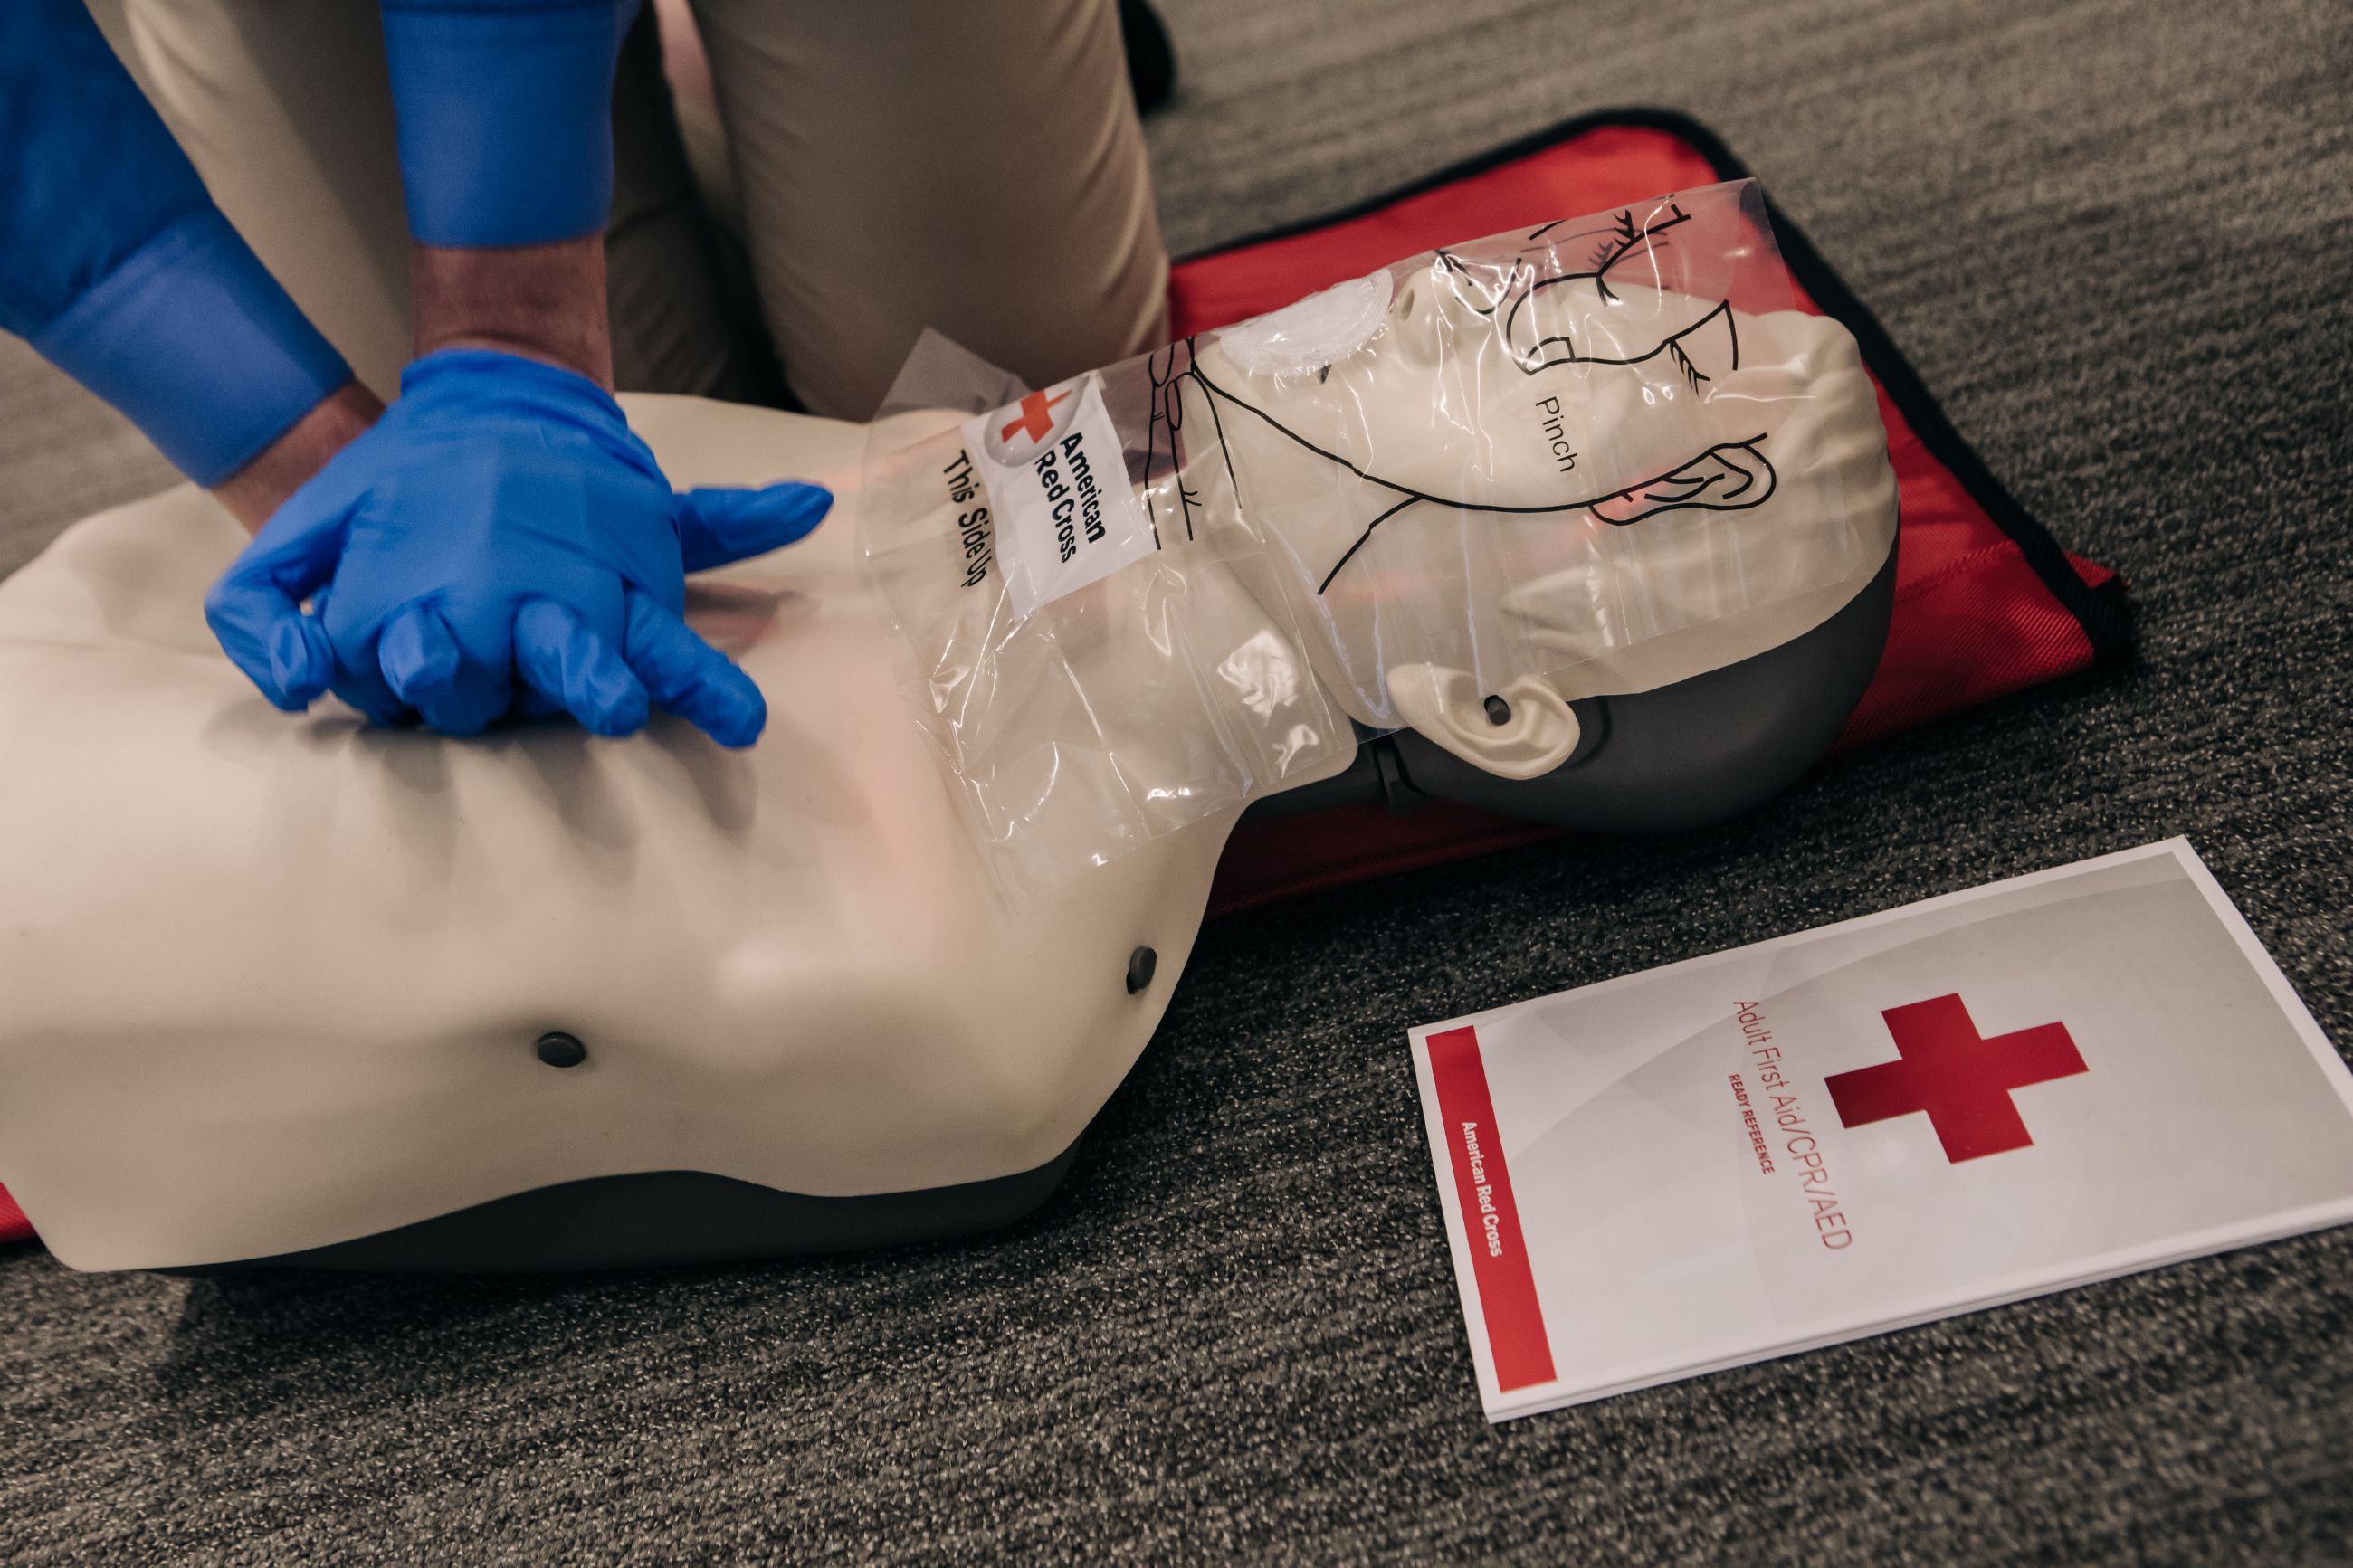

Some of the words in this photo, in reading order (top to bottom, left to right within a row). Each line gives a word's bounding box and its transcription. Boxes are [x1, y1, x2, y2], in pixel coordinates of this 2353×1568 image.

[1535, 396, 1578, 472] Pinch
[943, 449, 980, 504] This
[1060, 432, 1106, 544] American
[957, 507, 992, 558] Side
[1034, 449, 1070, 502] Red
[1052, 499, 1077, 564] Cross
[960, 552, 992, 588] Up
[1733, 1001, 1772, 1046] Adult
[1752, 1047, 1790, 1091] First
[1729, 1074, 1751, 1107] READY
[1741, 1110, 1776, 1175] REFERENCE
[1462, 1122, 1487, 1184] American
[1769, 1095, 1853, 1250] Aid/CPR/AED
[1476, 1184, 1497, 1213] Red
[1483, 1214, 1503, 1258] Cross
